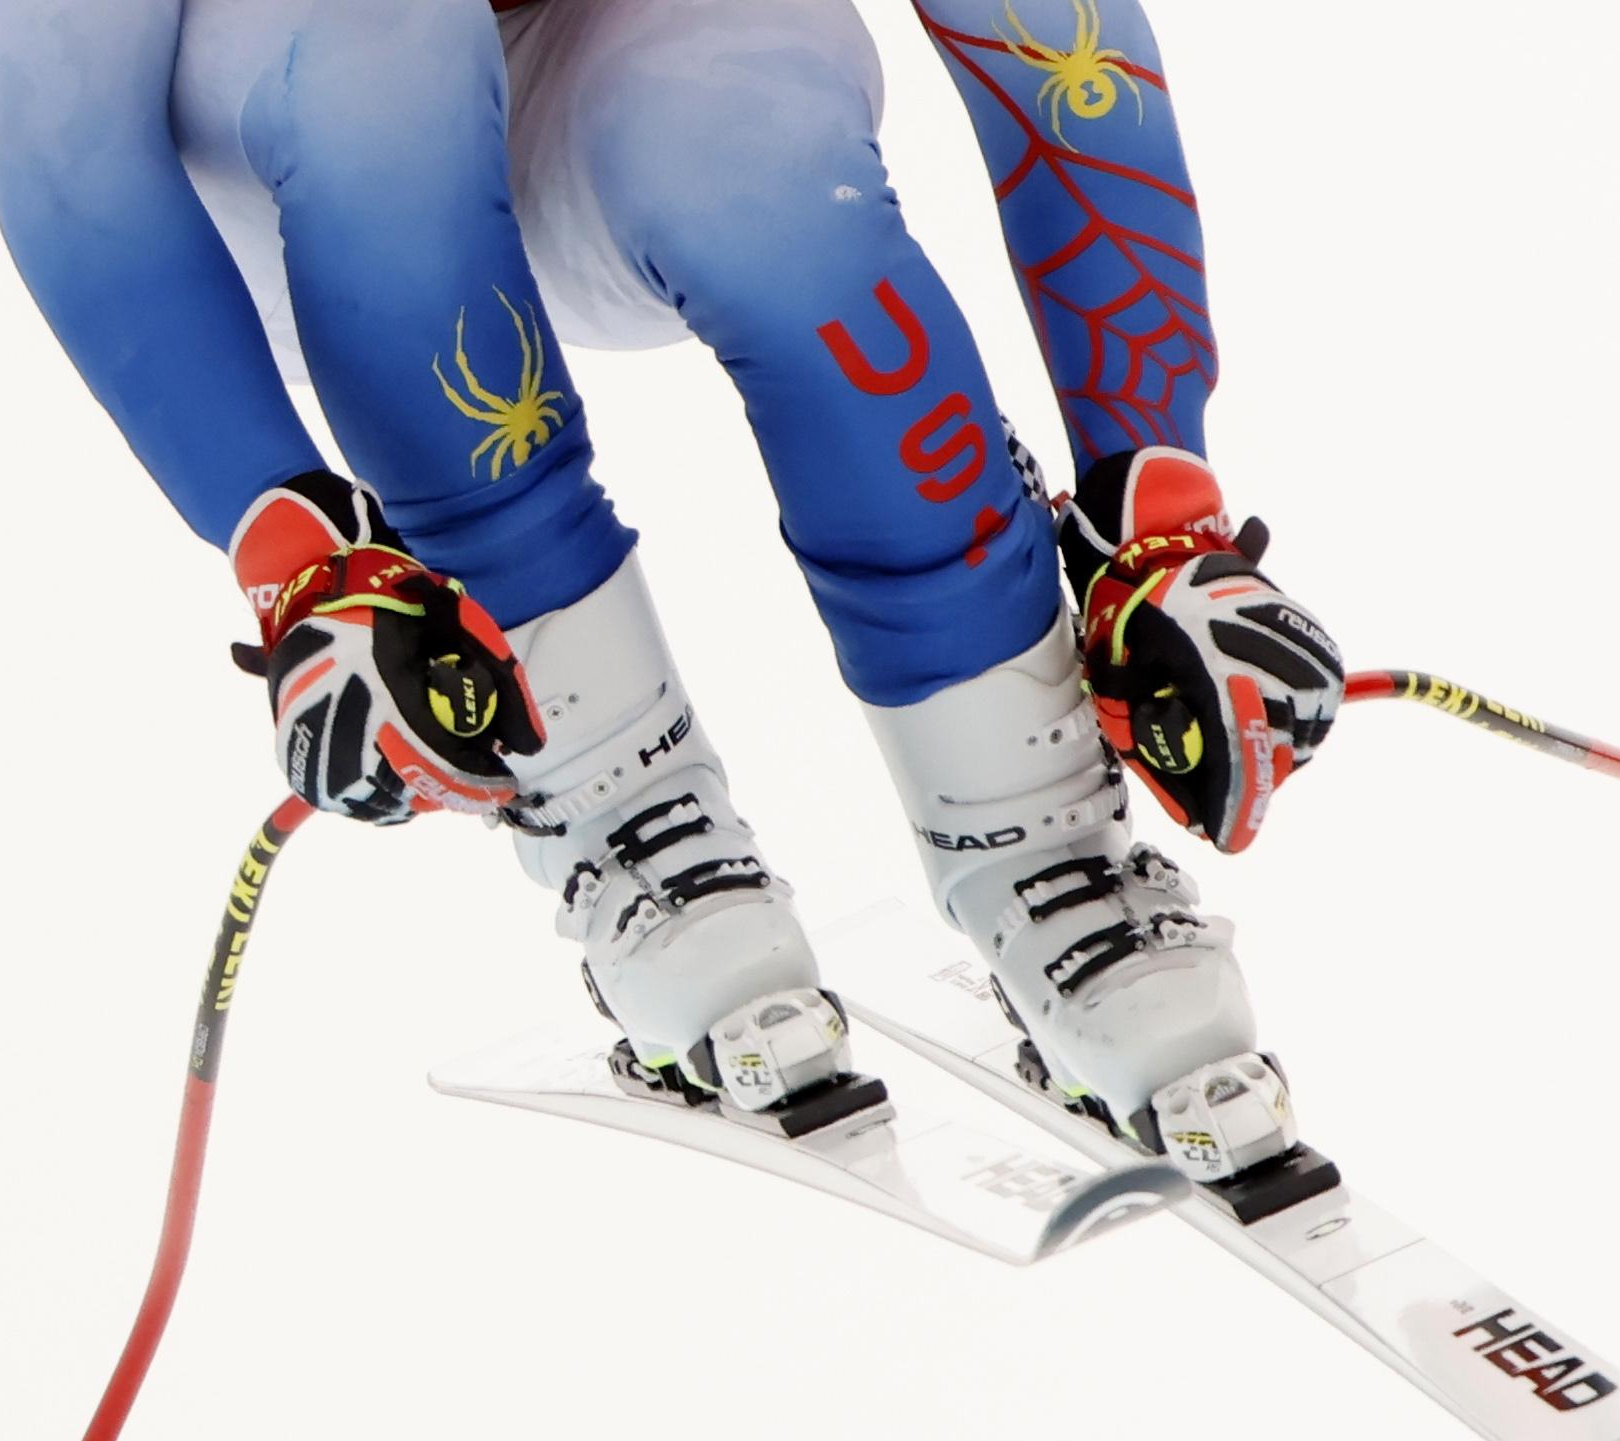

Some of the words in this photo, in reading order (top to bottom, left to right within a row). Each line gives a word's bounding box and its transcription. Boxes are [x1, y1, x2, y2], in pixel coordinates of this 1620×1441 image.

[462, 677, 477, 726] LEKI
[1150, 724, 1178, 767] LEKI
[911, 820, 1027, 851] HEAD
[1452, 1307, 1618, 1412] HEAD
